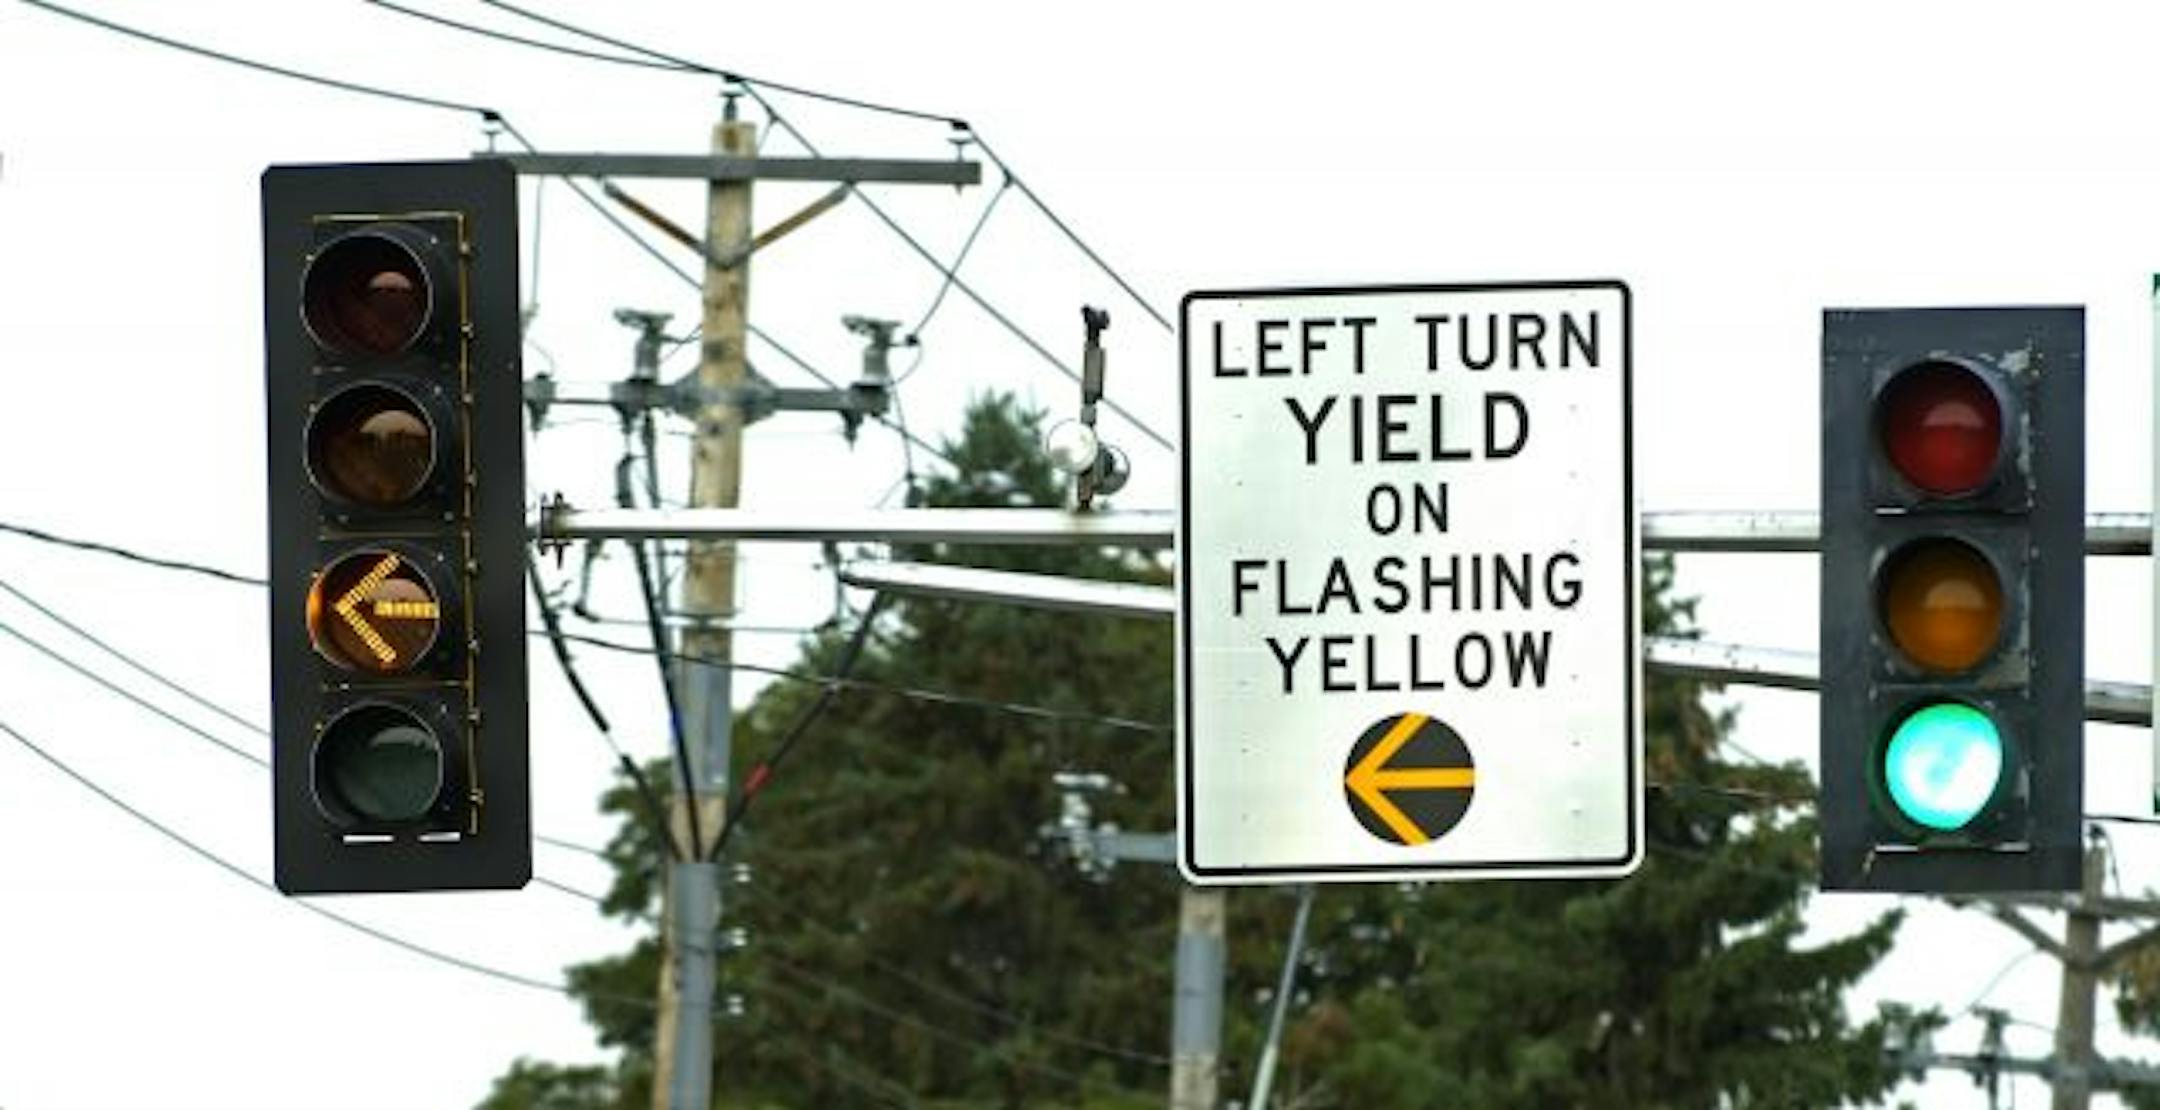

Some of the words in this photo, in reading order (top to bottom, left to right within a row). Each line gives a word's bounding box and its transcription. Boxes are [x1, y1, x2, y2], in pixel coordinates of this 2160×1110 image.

[1213, 318, 1377, 378] LEFT
[1415, 311, 1600, 371] TURN
[1284, 392, 1530, 465] YIELD
[1367, 482, 1449, 536] ON
[1233, 552, 1583, 617] FLASHING
[1265, 631, 1553, 694] YELLOW
